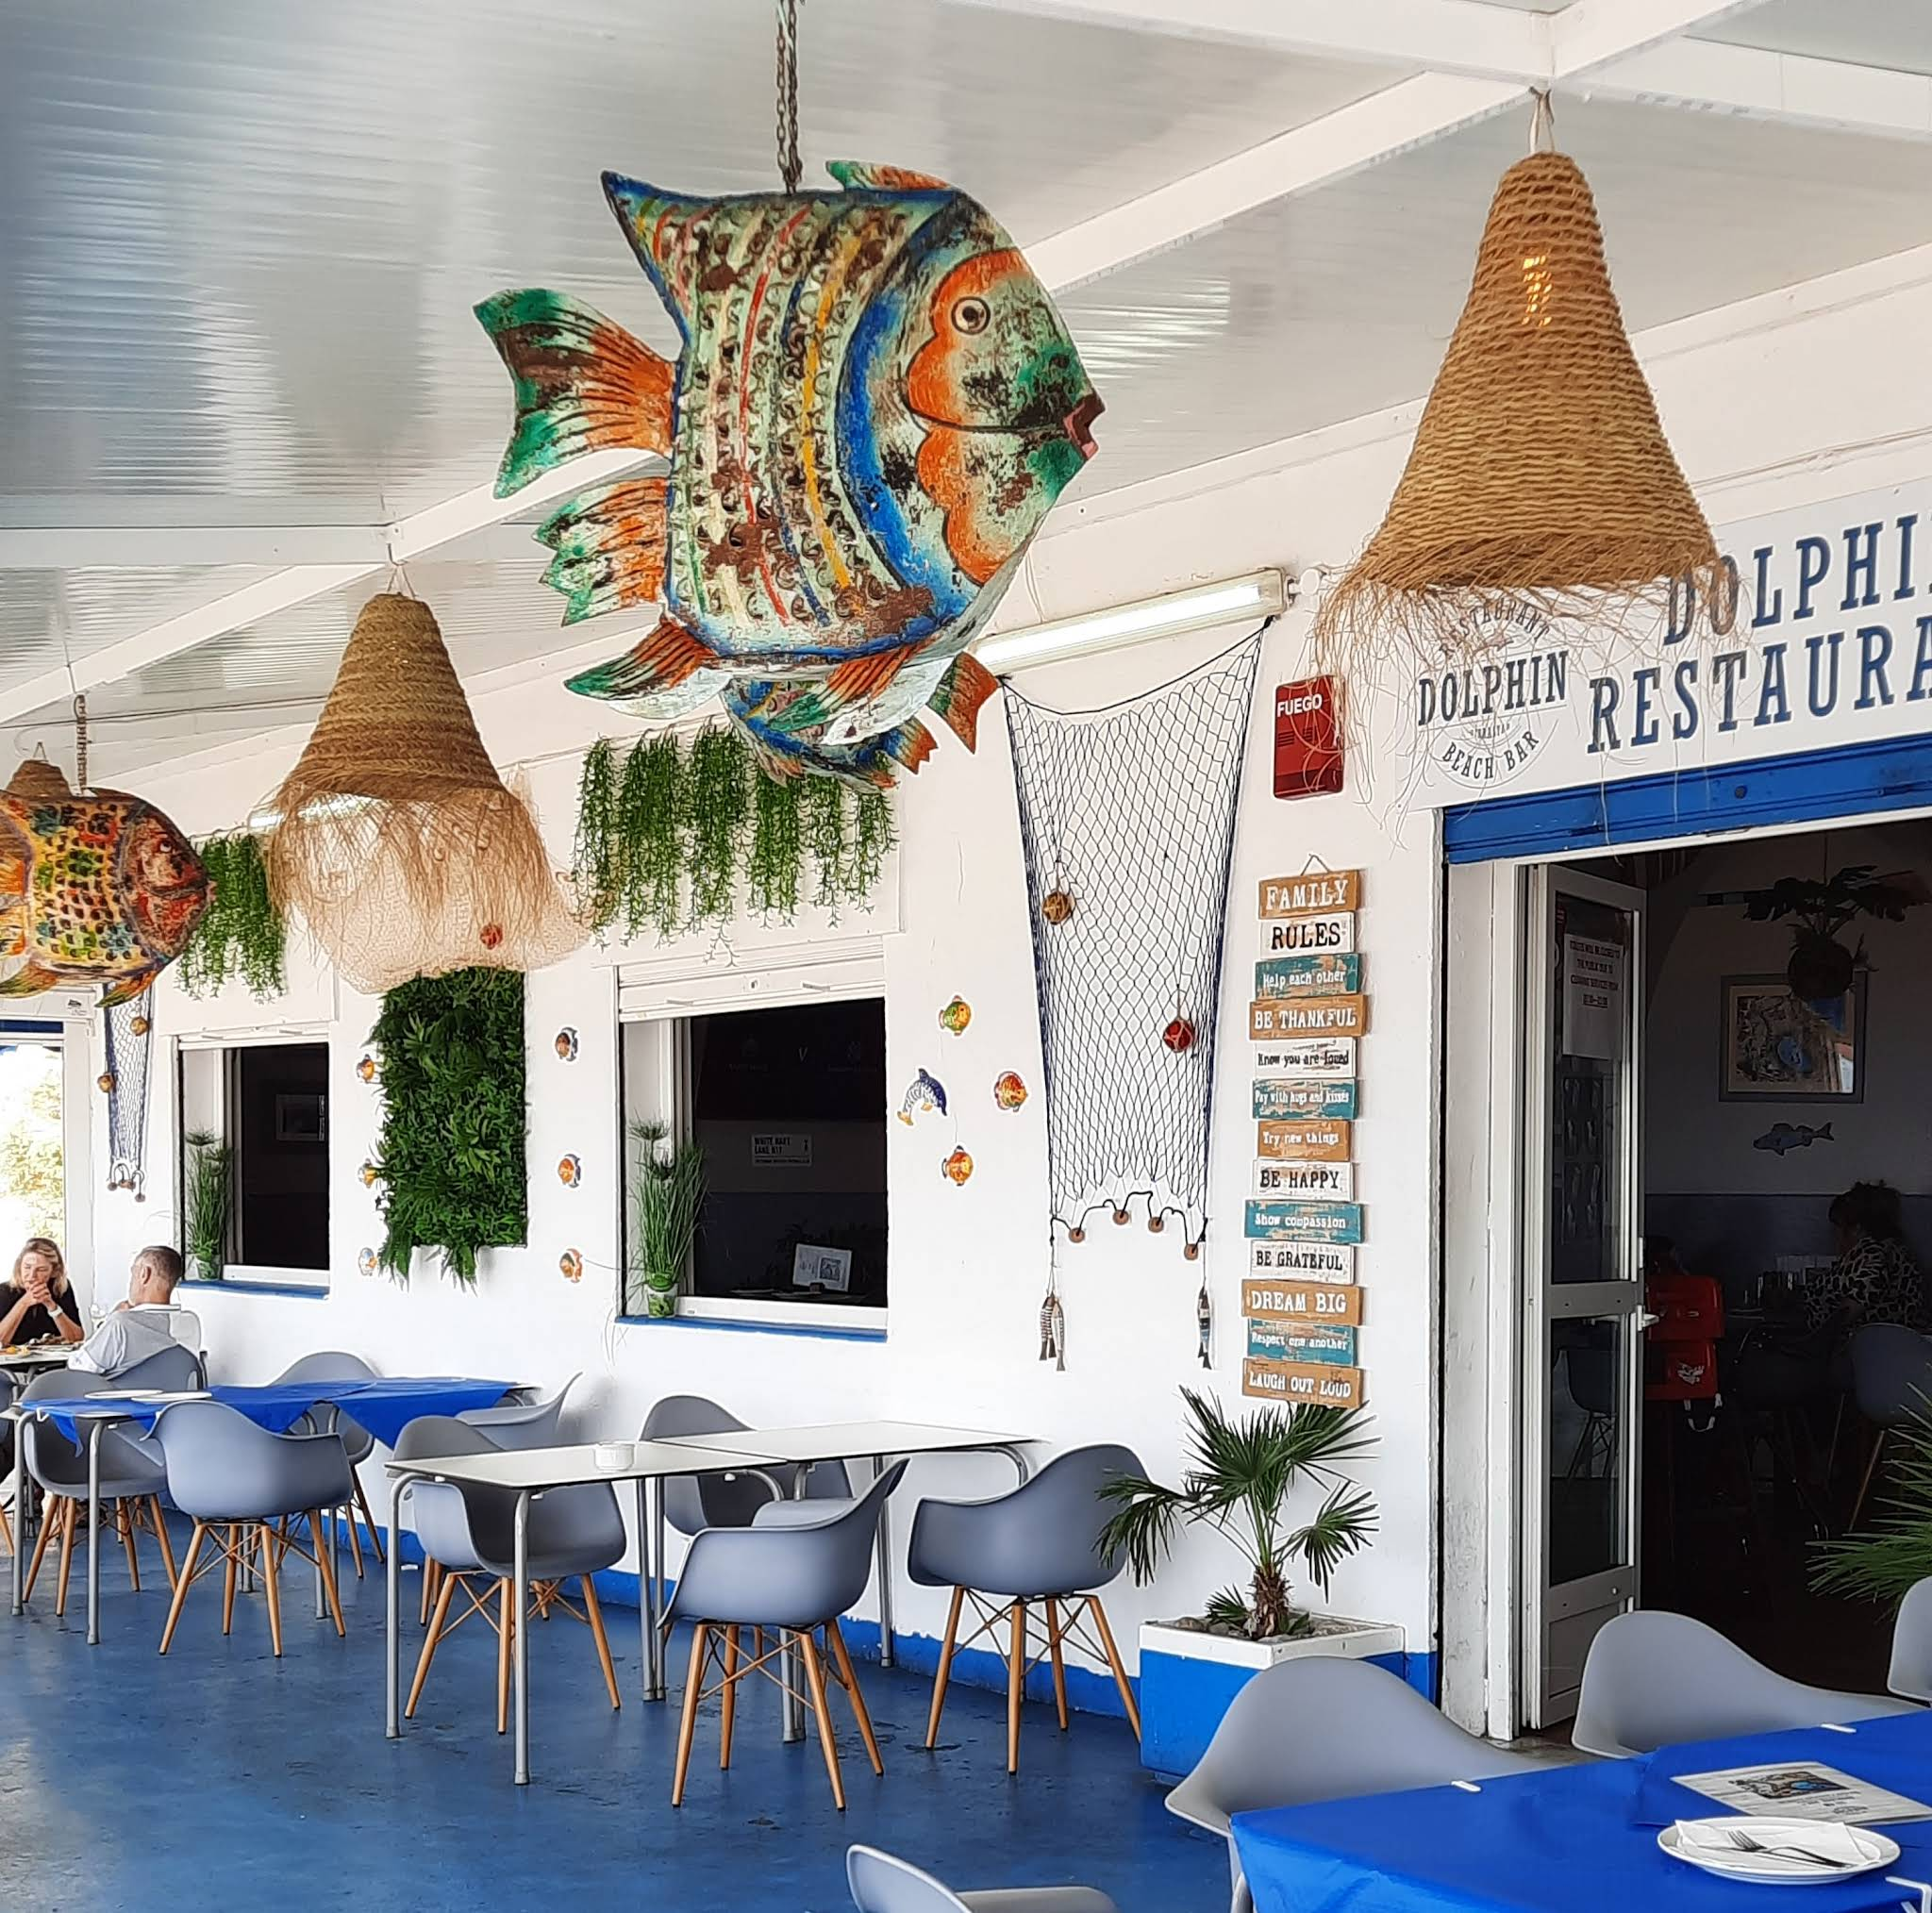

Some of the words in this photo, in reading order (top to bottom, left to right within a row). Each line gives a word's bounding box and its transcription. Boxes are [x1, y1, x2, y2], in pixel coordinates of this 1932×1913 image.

[1663, 513, 1932, 646] DOLPHI
[1418, 649, 1569, 726] DOLPHIN
[1276, 693, 1323, 718] FUEGO
[1442, 741, 1494, 779] BEACH
[1503, 731, 1540, 772] BAR
[1265, 879, 1348, 910] FAMILY
[1271, 923, 1341, 950] RULES
[1262, 973, 1286, 990] Help
[1289, 972, 1312, 985] each
[1316, 970, 1346, 983] other
[1255, 1010, 1274, 1029] BE
[1279, 1007, 1357, 1029] THANKFUL
[1257, 1053, 1280, 1066] Know
[1284, 1056, 1300, 1068] you
[1303, 1055, 1320, 1065] are
[1262, 1131, 1280, 1147] Try
[1284, 1134, 1302, 1144] new
[1306, 1132, 1339, 1146] things
[1259, 1170, 1281, 1188] BE
[1289, 1171, 1340, 1189] HAPPY
[1255, 1213, 1281, 1226] Show
[1285, 1214, 1346, 1229] compassion
[1256, 1251, 1272, 1266] BE
[1276, 1251, 1343, 1271] GRATEFUL
[1251, 1290, 1307, 1312] DREAM
[1315, 1292, 1347, 1313] BIG
[1251, 1332, 1285, 1347] Respect
[1308, 1338, 1347, 1351] another
[1249, 1372, 1286, 1390] LAUGH
[1291, 1376, 1314, 1393] OUT
[1320, 1380, 1351, 1397] LOUD
